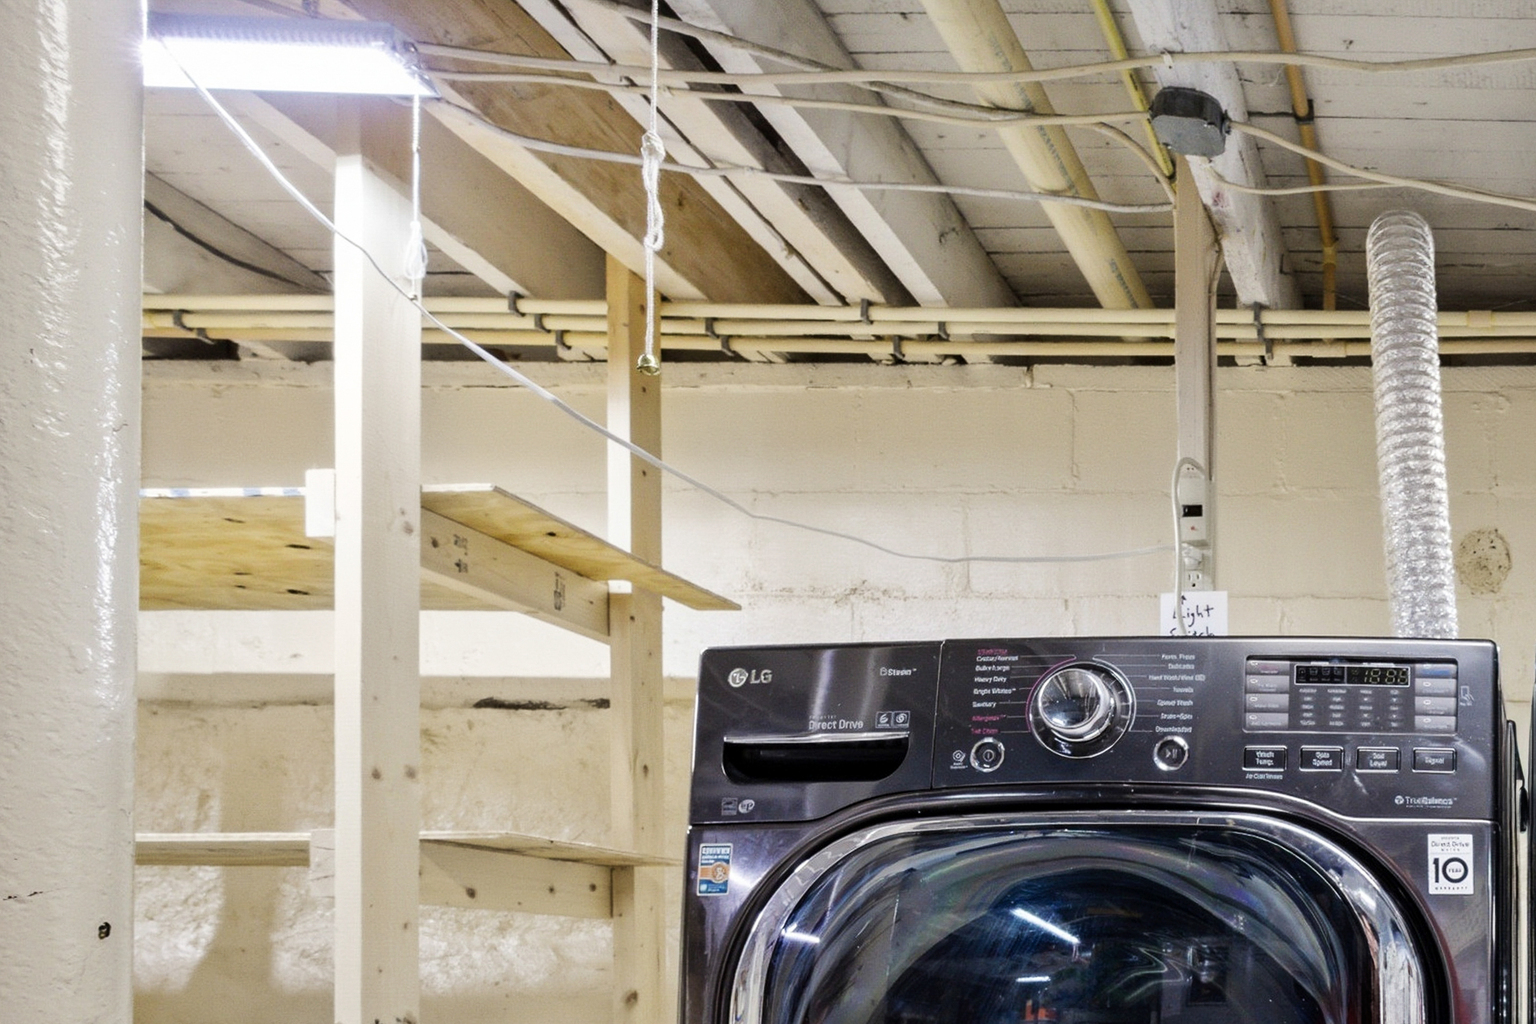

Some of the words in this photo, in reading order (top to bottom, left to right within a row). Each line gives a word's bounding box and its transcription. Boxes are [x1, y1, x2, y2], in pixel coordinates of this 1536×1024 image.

[750, 669, 772, 684] LG
[808, 720, 837, 730] Direct
[838, 719, 864, 729] Drive
[1433, 857, 1469, 884] 10
